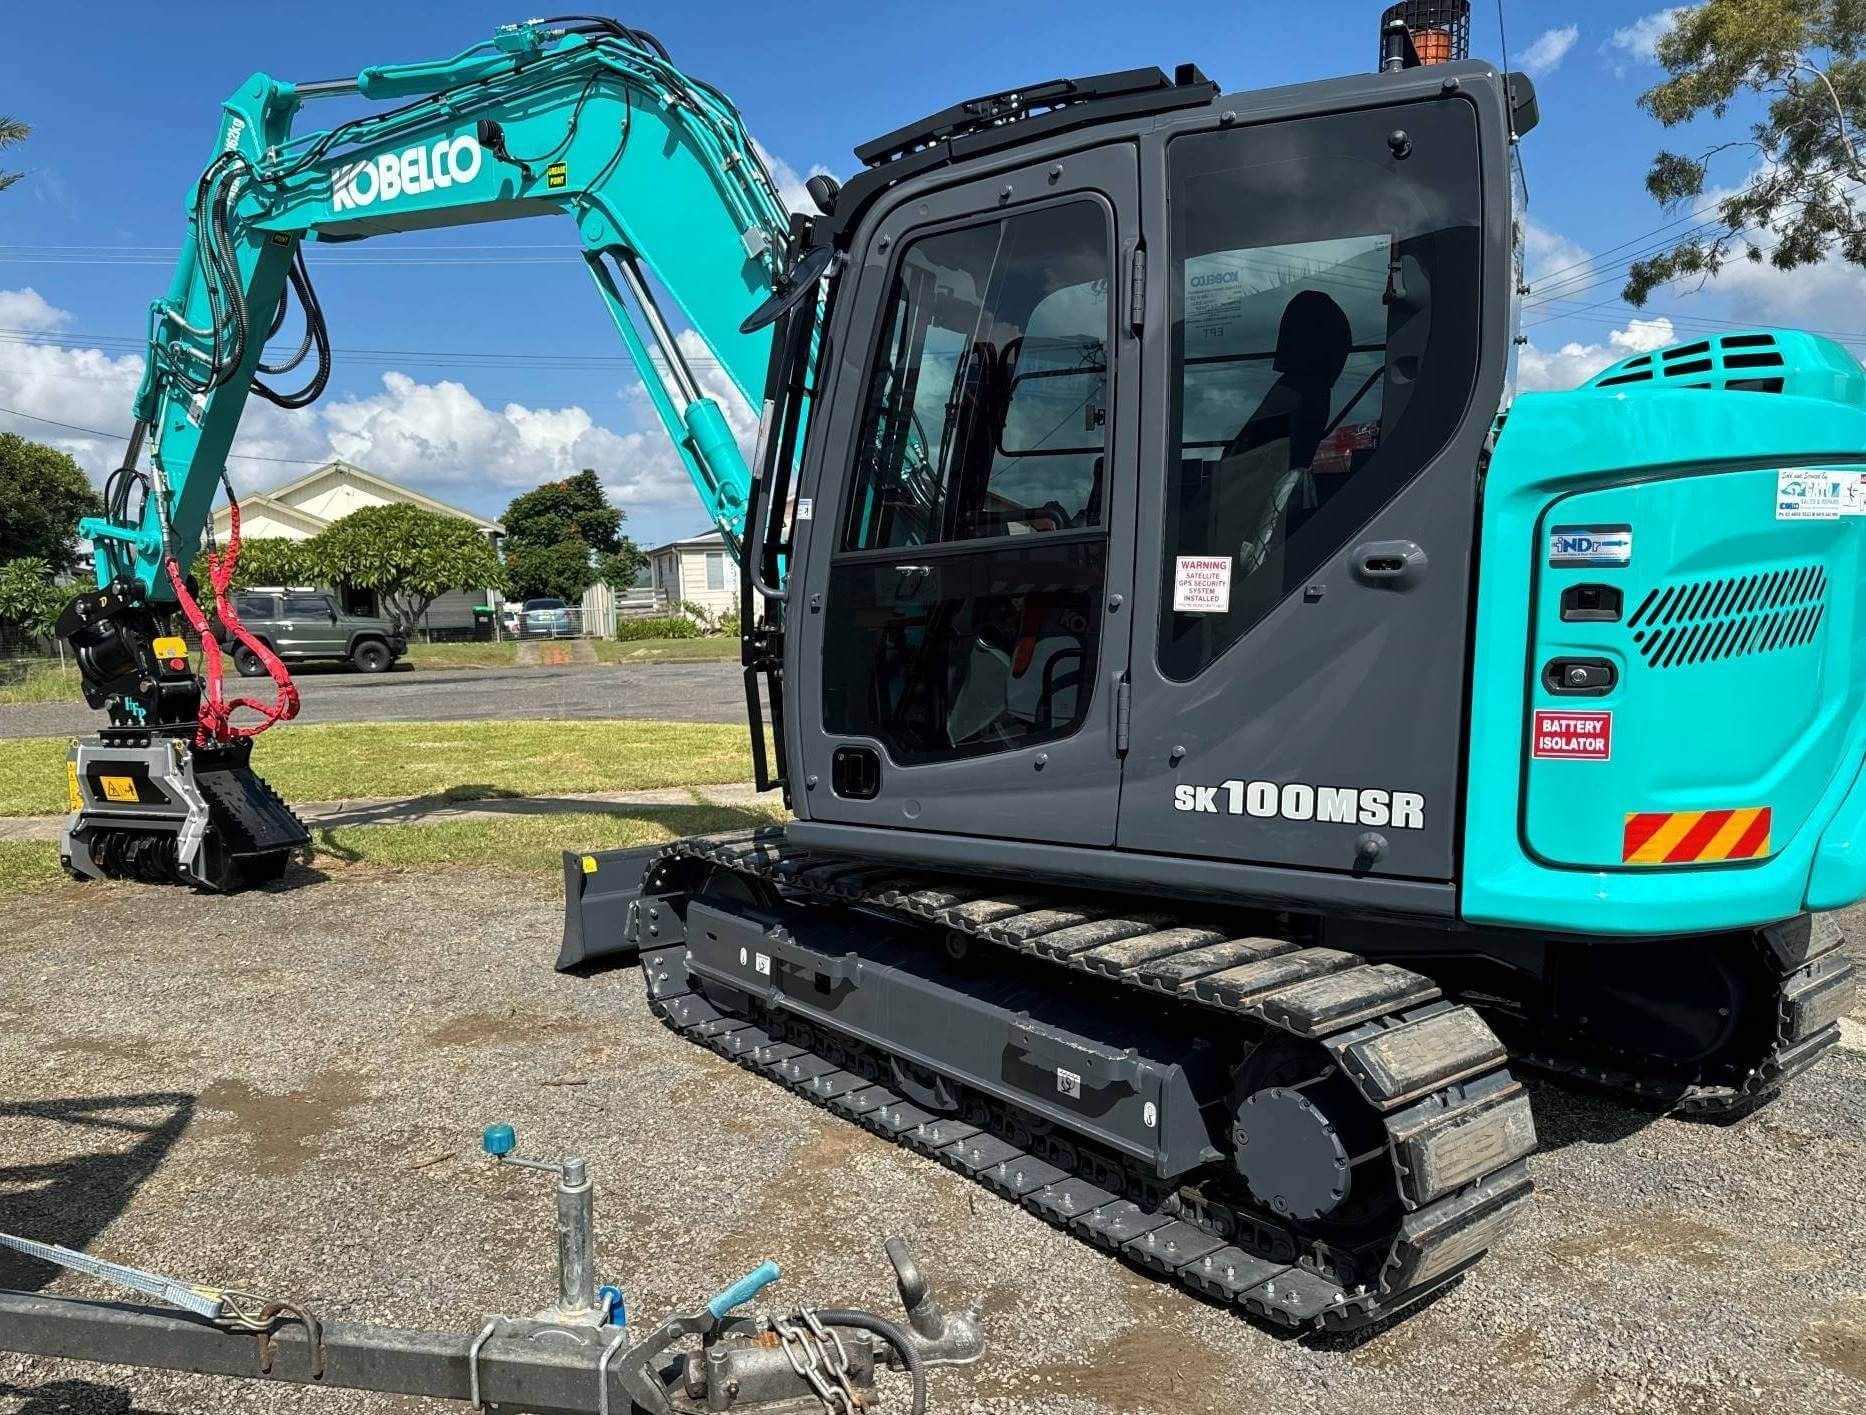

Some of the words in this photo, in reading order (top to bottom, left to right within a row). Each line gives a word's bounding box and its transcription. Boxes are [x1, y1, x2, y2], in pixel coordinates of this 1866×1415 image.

[331, 134, 482, 212] KOBELCO
[1181, 560, 1227, 570] WARNING
[1185, 572, 1221, 580] SATELLITE
[1178, 579, 1193, 587] GPS
[1194, 580, 1227, 588] SECURITY
[1188, 587, 1216, 595] SYSTEM
[1542, 719, 1604, 733] BATTERY
[1539, 736, 1605, 751] ISOLATOR
[1173, 779, 1425, 830] SK100MSR
